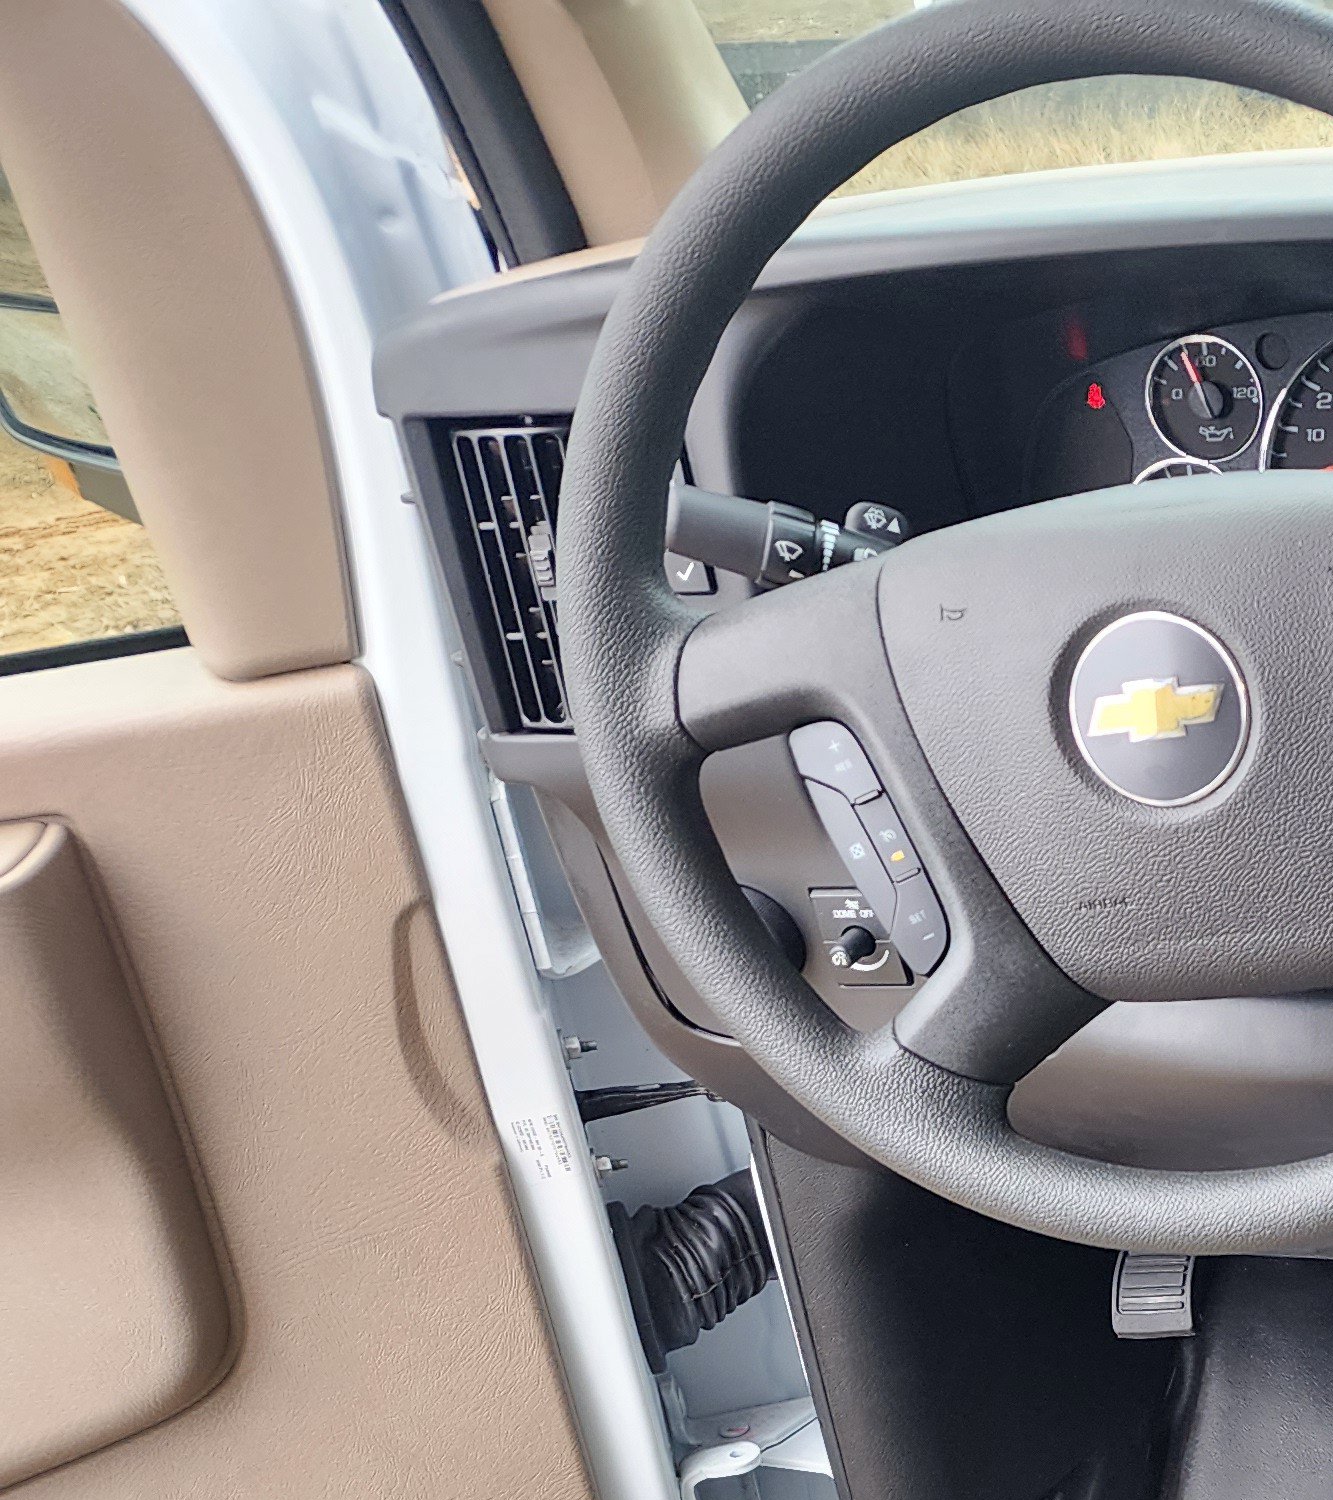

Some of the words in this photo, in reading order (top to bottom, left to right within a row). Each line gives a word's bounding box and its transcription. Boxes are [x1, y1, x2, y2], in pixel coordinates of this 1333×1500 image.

[1171, 388, 1183, 400] 0
[1232, 386, 1258, 399] 120
[1306, 428, 1325, 442] 10
